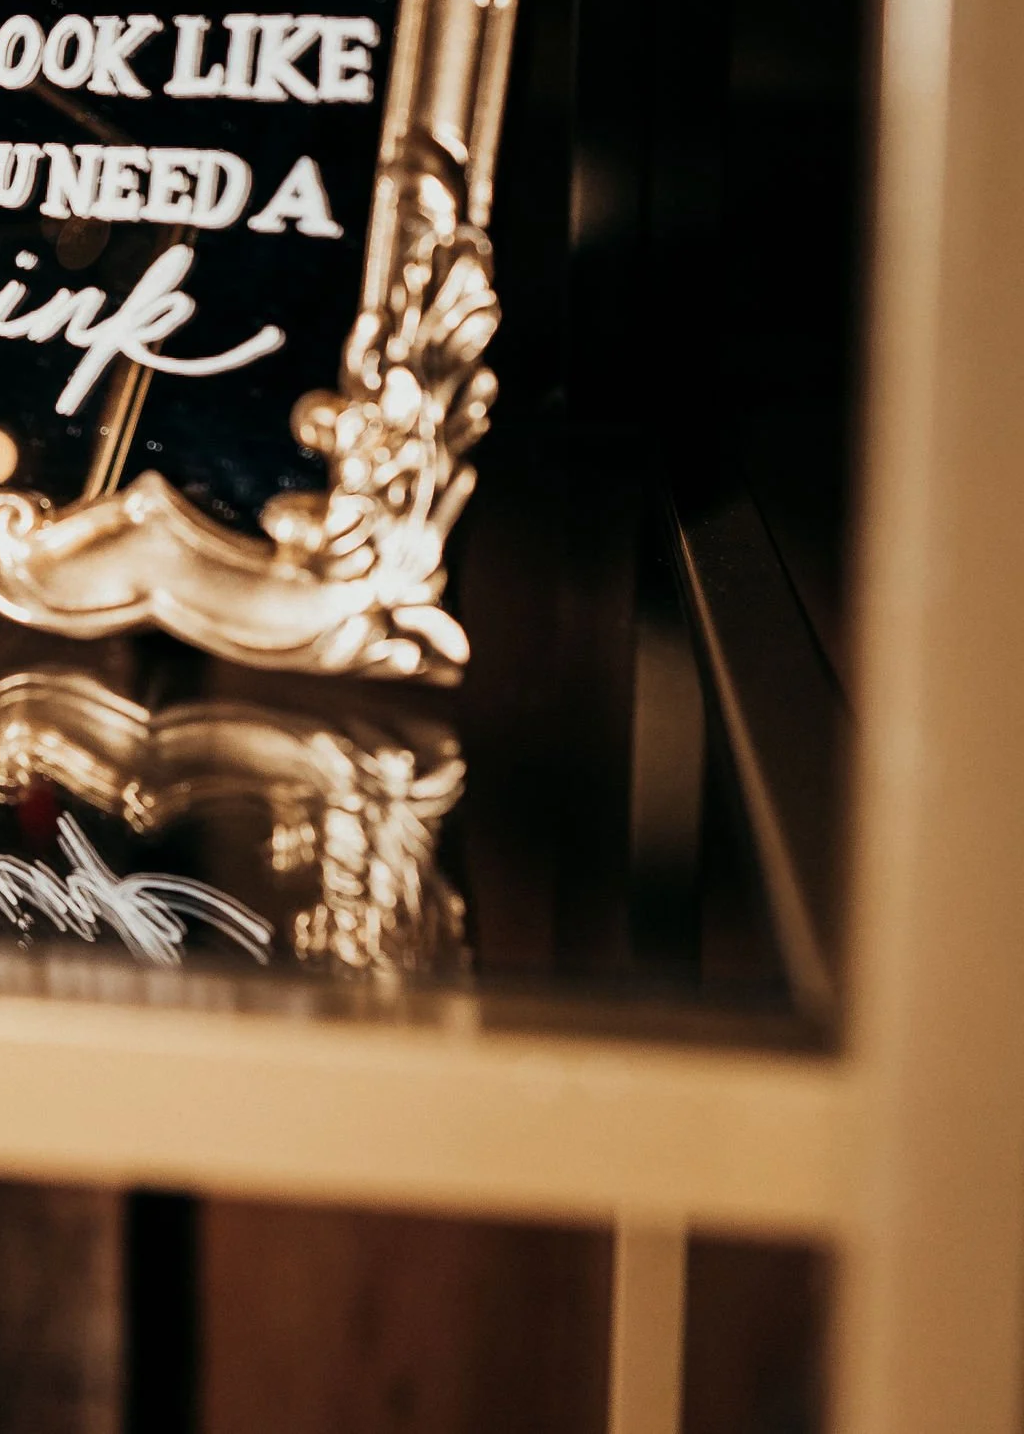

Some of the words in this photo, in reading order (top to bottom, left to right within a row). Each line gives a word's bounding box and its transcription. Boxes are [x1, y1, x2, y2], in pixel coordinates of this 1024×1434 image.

[164, 14, 376, 102] LIKE
[38, 142, 252, 228] NEED
[248, 156, 343, 238] A
